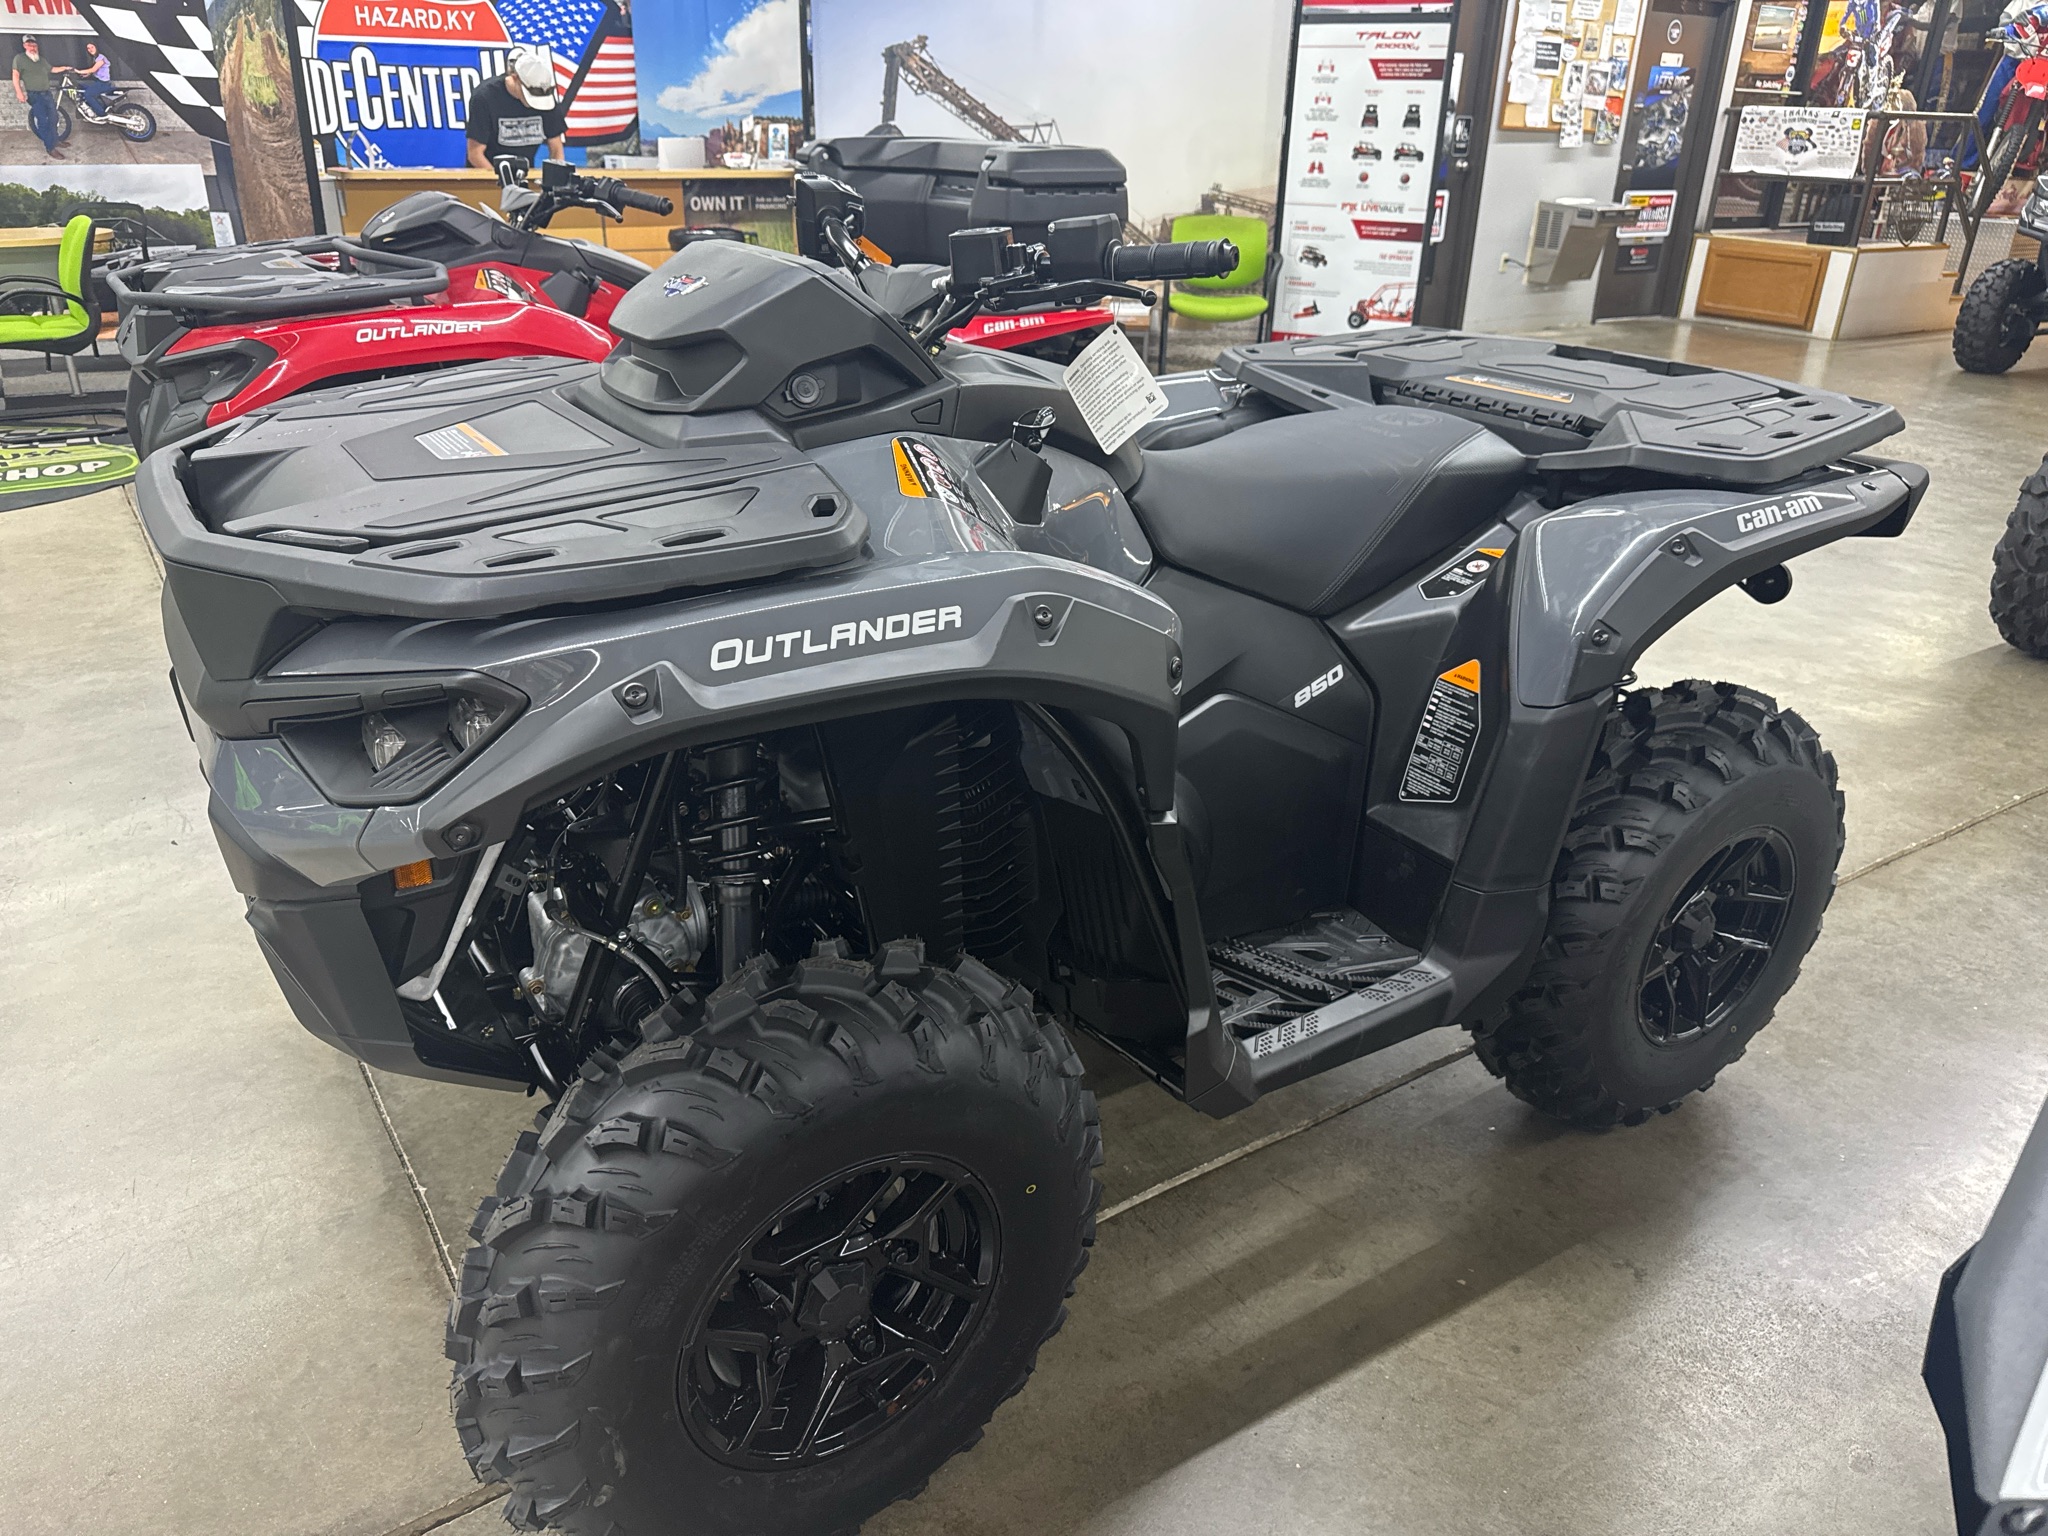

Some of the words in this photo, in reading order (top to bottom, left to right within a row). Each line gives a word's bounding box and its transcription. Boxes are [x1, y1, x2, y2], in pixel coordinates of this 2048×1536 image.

[1356, 31, 1421, 40] TALON
[690, 196, 726, 211] OWN
[730, 196, 744, 211] IT
[356, 321, 482, 343] OUTLANDER
[984, 316, 1045, 334] can-am
[0, 460, 111, 481] HOP
[1736, 495, 1823, 533] can-am
[710, 605, 962, 672] OUTLANDER
[1294, 664, 1344, 708] 850
